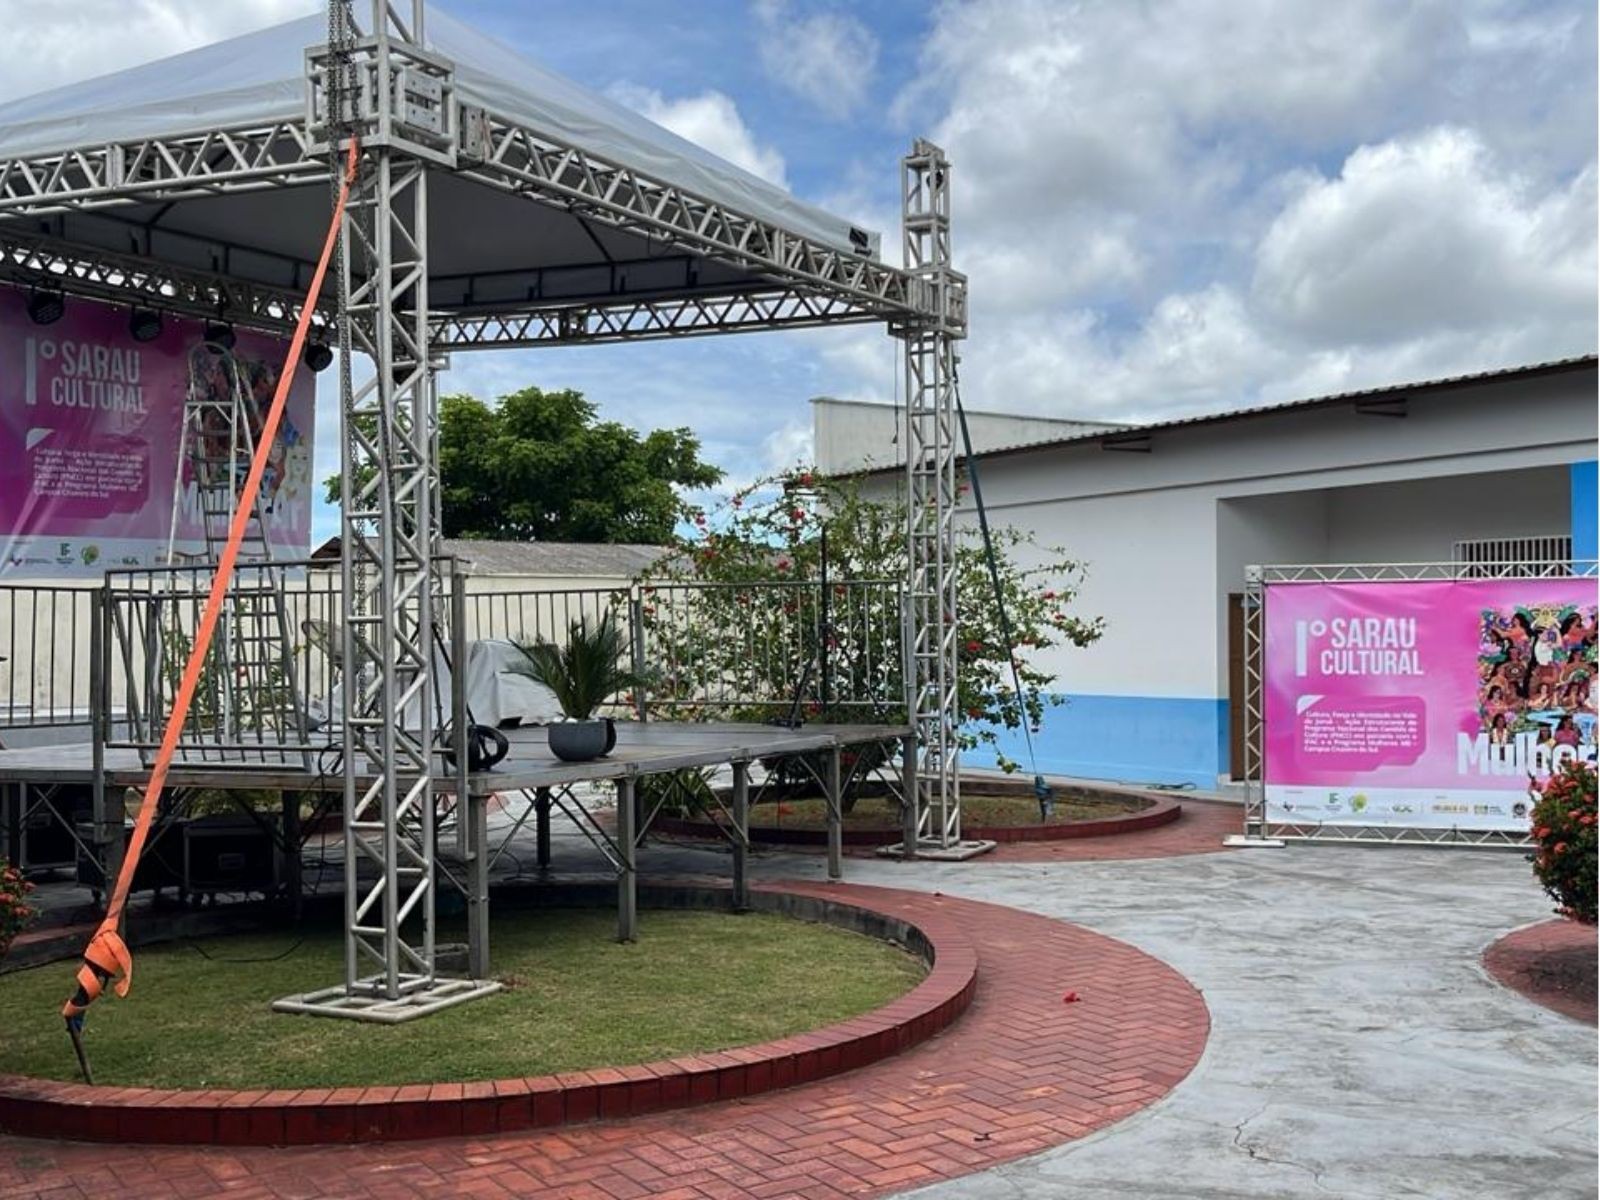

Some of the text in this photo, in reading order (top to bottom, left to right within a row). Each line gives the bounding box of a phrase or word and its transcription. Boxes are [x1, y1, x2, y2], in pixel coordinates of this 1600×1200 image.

[61, 341, 140, 384] SARAU
[51, 376, 149, 414] CULTURAL
[1331, 617, 1416, 649] SARAU
[1321, 649, 1424, 675] CULTURAL
